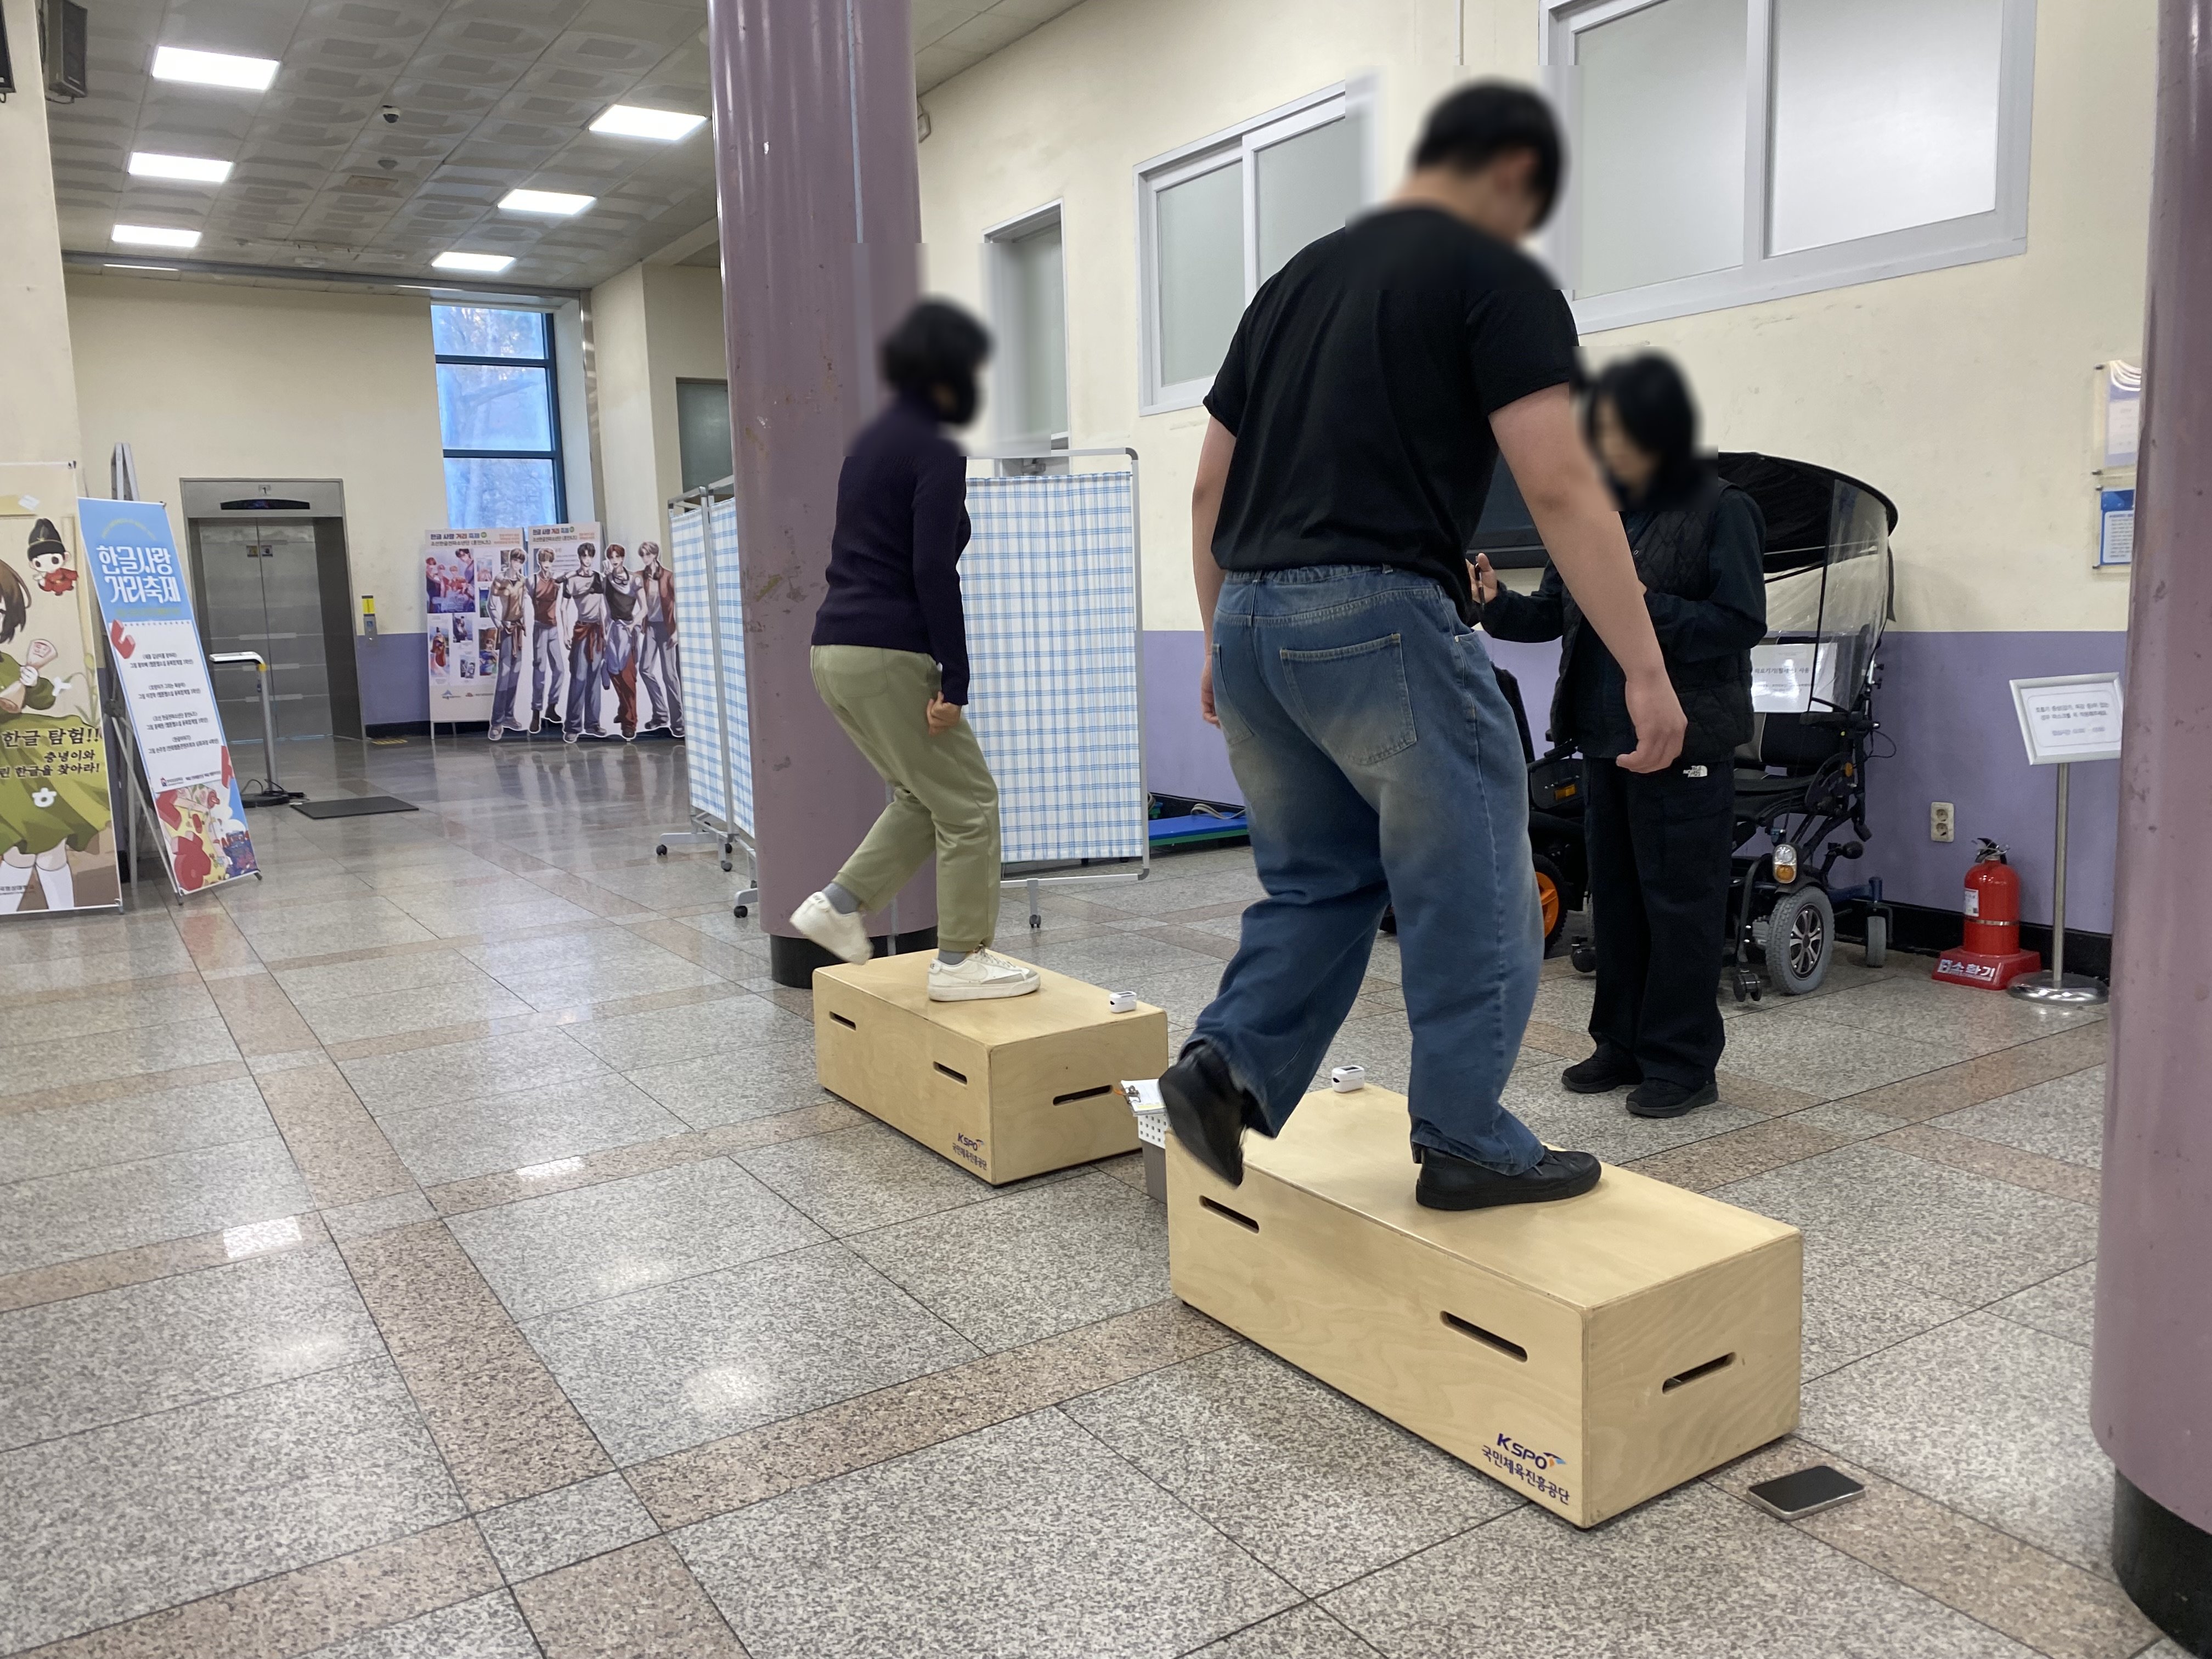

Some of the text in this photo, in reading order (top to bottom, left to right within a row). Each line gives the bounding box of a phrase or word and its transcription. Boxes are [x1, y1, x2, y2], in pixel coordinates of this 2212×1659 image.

[2, 727, 99, 747] 한글 탐험!!
[15, 764, 53, 777] 한글을
[58, 762, 100, 775] 찾아라!
[1951, 961, 1996, 978] 소화기
[957, 1133, 978, 1151] KSPO
[1497, 1433, 1547, 1470] KSPO
[1481, 1444, 1570, 1506] 국민체육진흥공단
